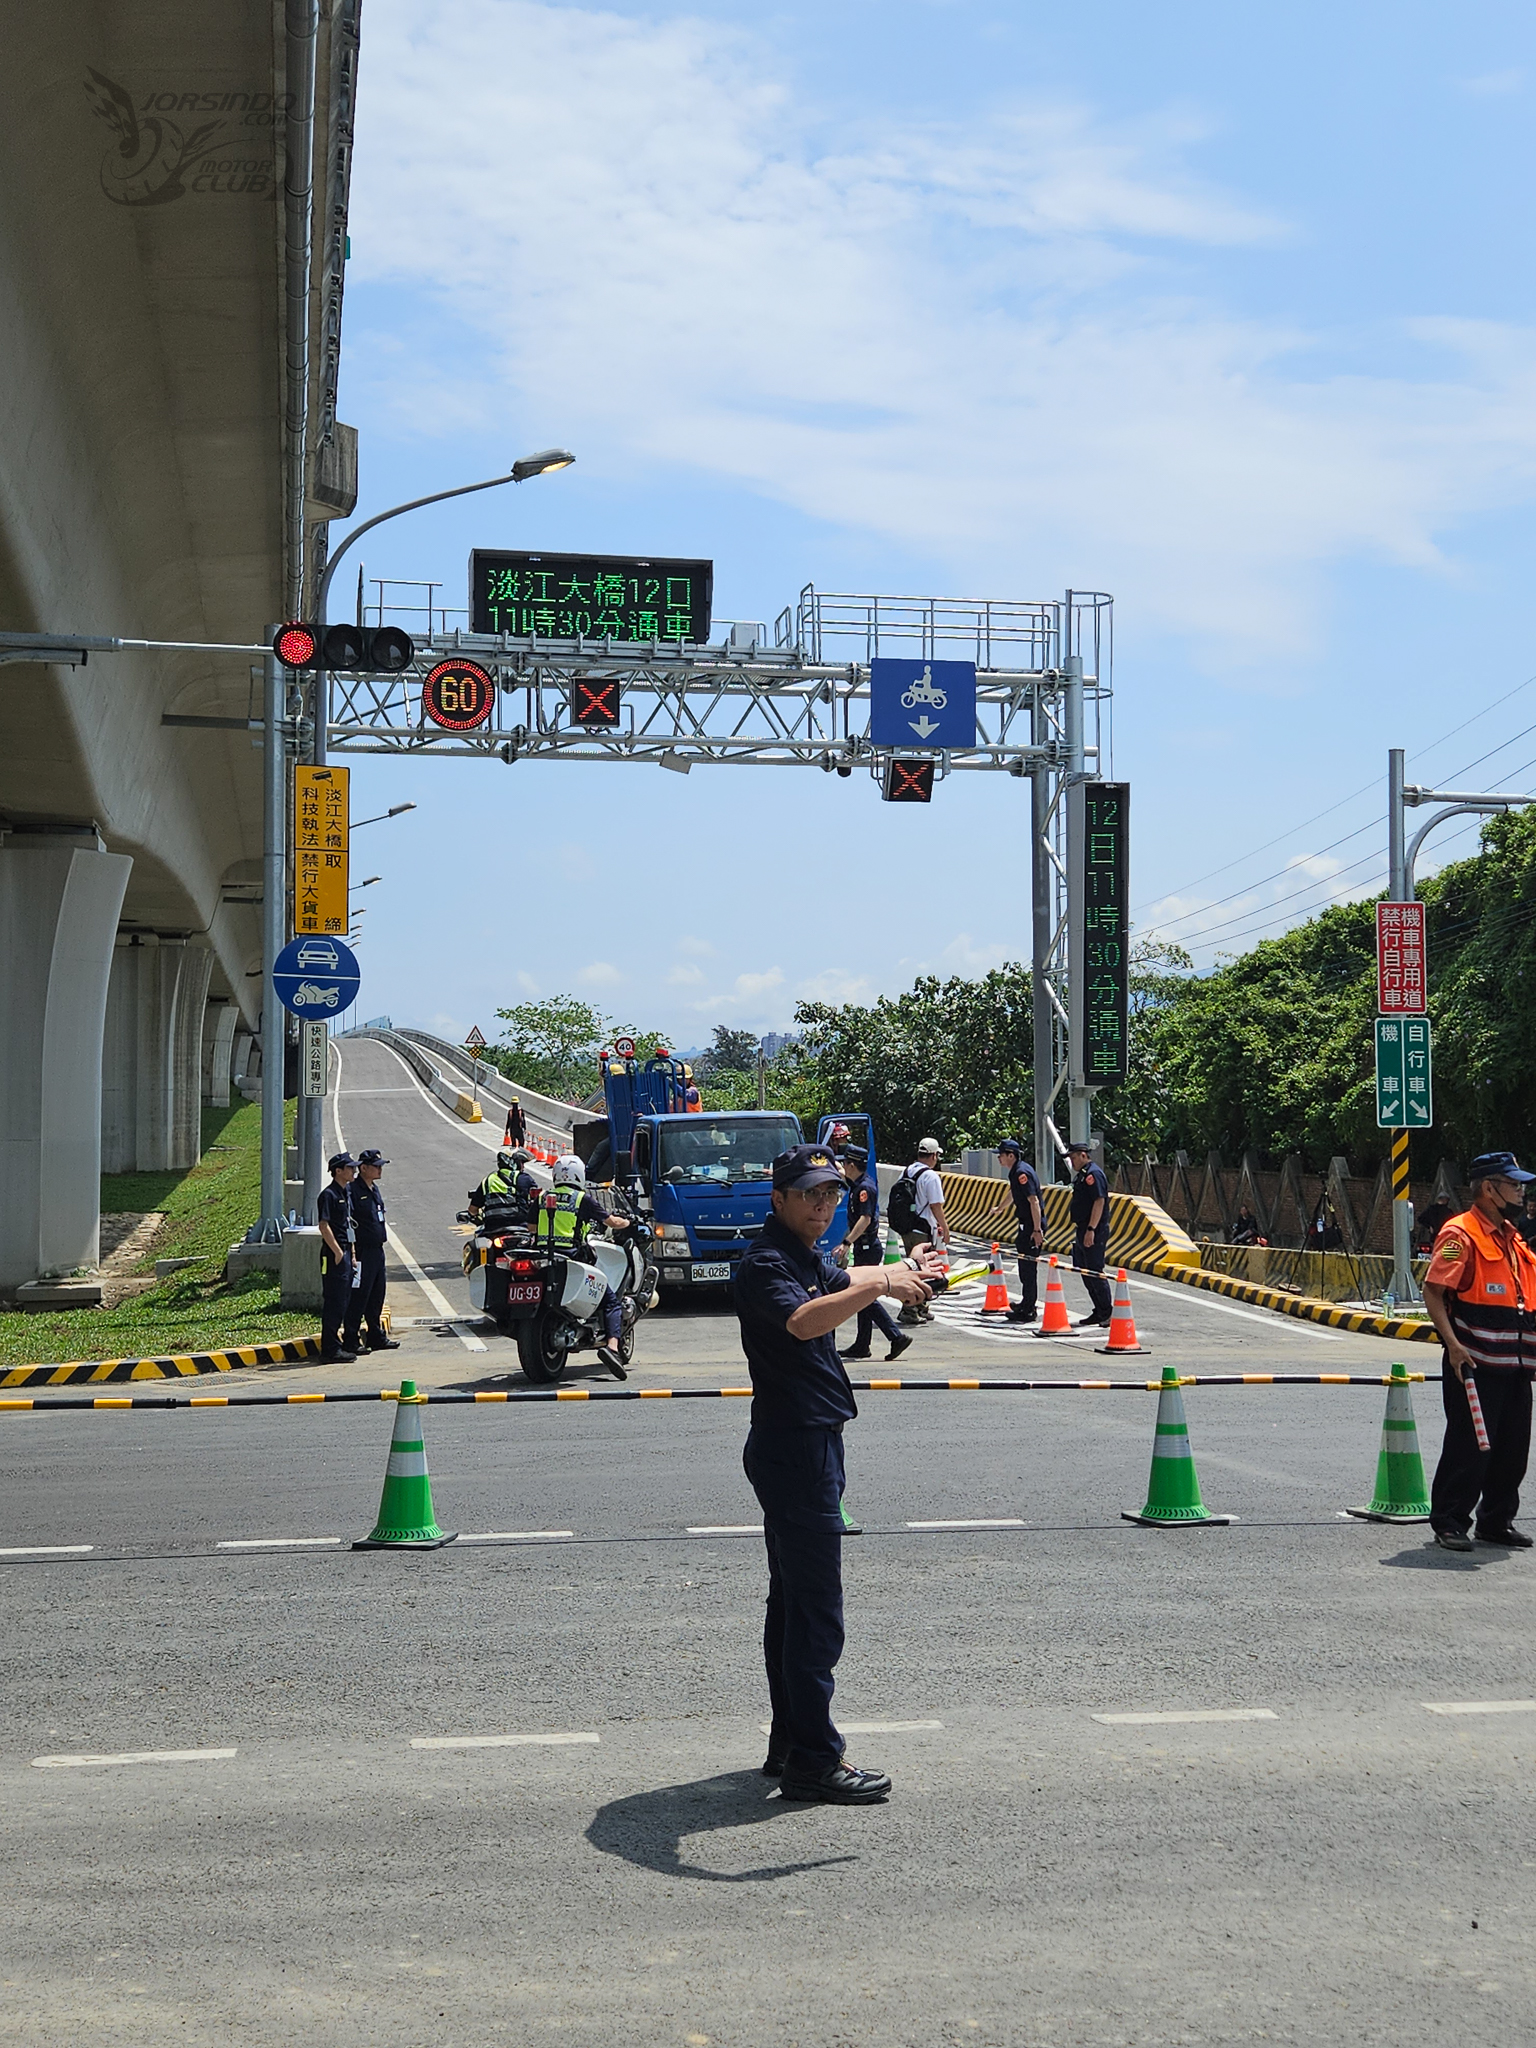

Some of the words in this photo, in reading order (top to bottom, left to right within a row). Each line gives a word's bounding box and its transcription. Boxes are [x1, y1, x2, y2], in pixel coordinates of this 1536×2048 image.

[487, 606, 696, 643] 11時30分通車
[440, 676, 478, 712] 60
[301, 786, 320, 847] 科技執法
[325, 788, 343, 849] 淡江大橋
[301, 853, 319, 932] 禁行大貨車
[1381, 907, 1402, 1008] 禁行自行車
[1401, 907, 1422, 1008] 機車專用道
[619, 1043, 631, 1051] 40
[1407, 1024, 1426, 1094] 自行車
[509, 1286, 541, 1301] UG-93
